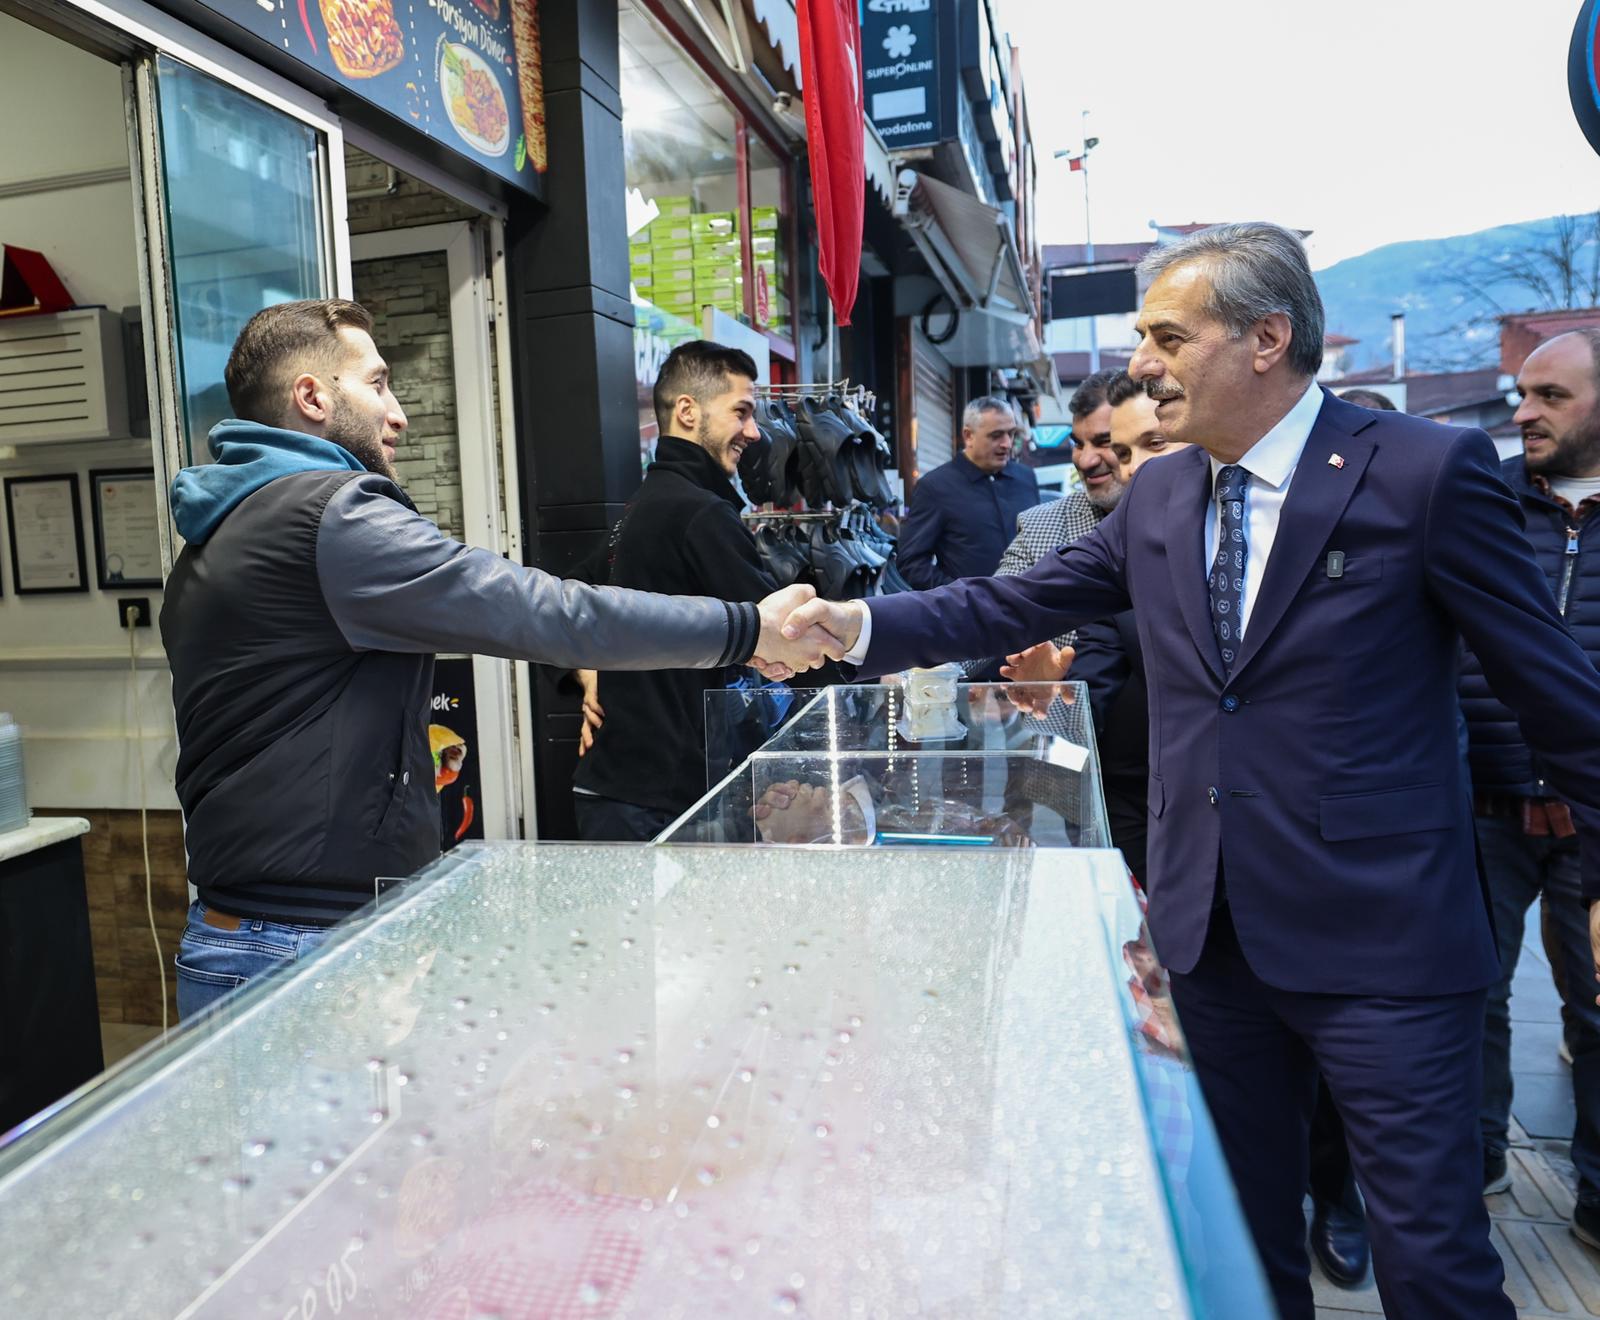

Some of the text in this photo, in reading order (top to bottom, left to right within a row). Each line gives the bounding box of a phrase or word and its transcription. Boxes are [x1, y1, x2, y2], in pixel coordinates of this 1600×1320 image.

[437, 0, 479, 46] Porsiyon
[866, 59, 933, 80] SUPERONLINE
[878, 120, 933, 137] vodafone
